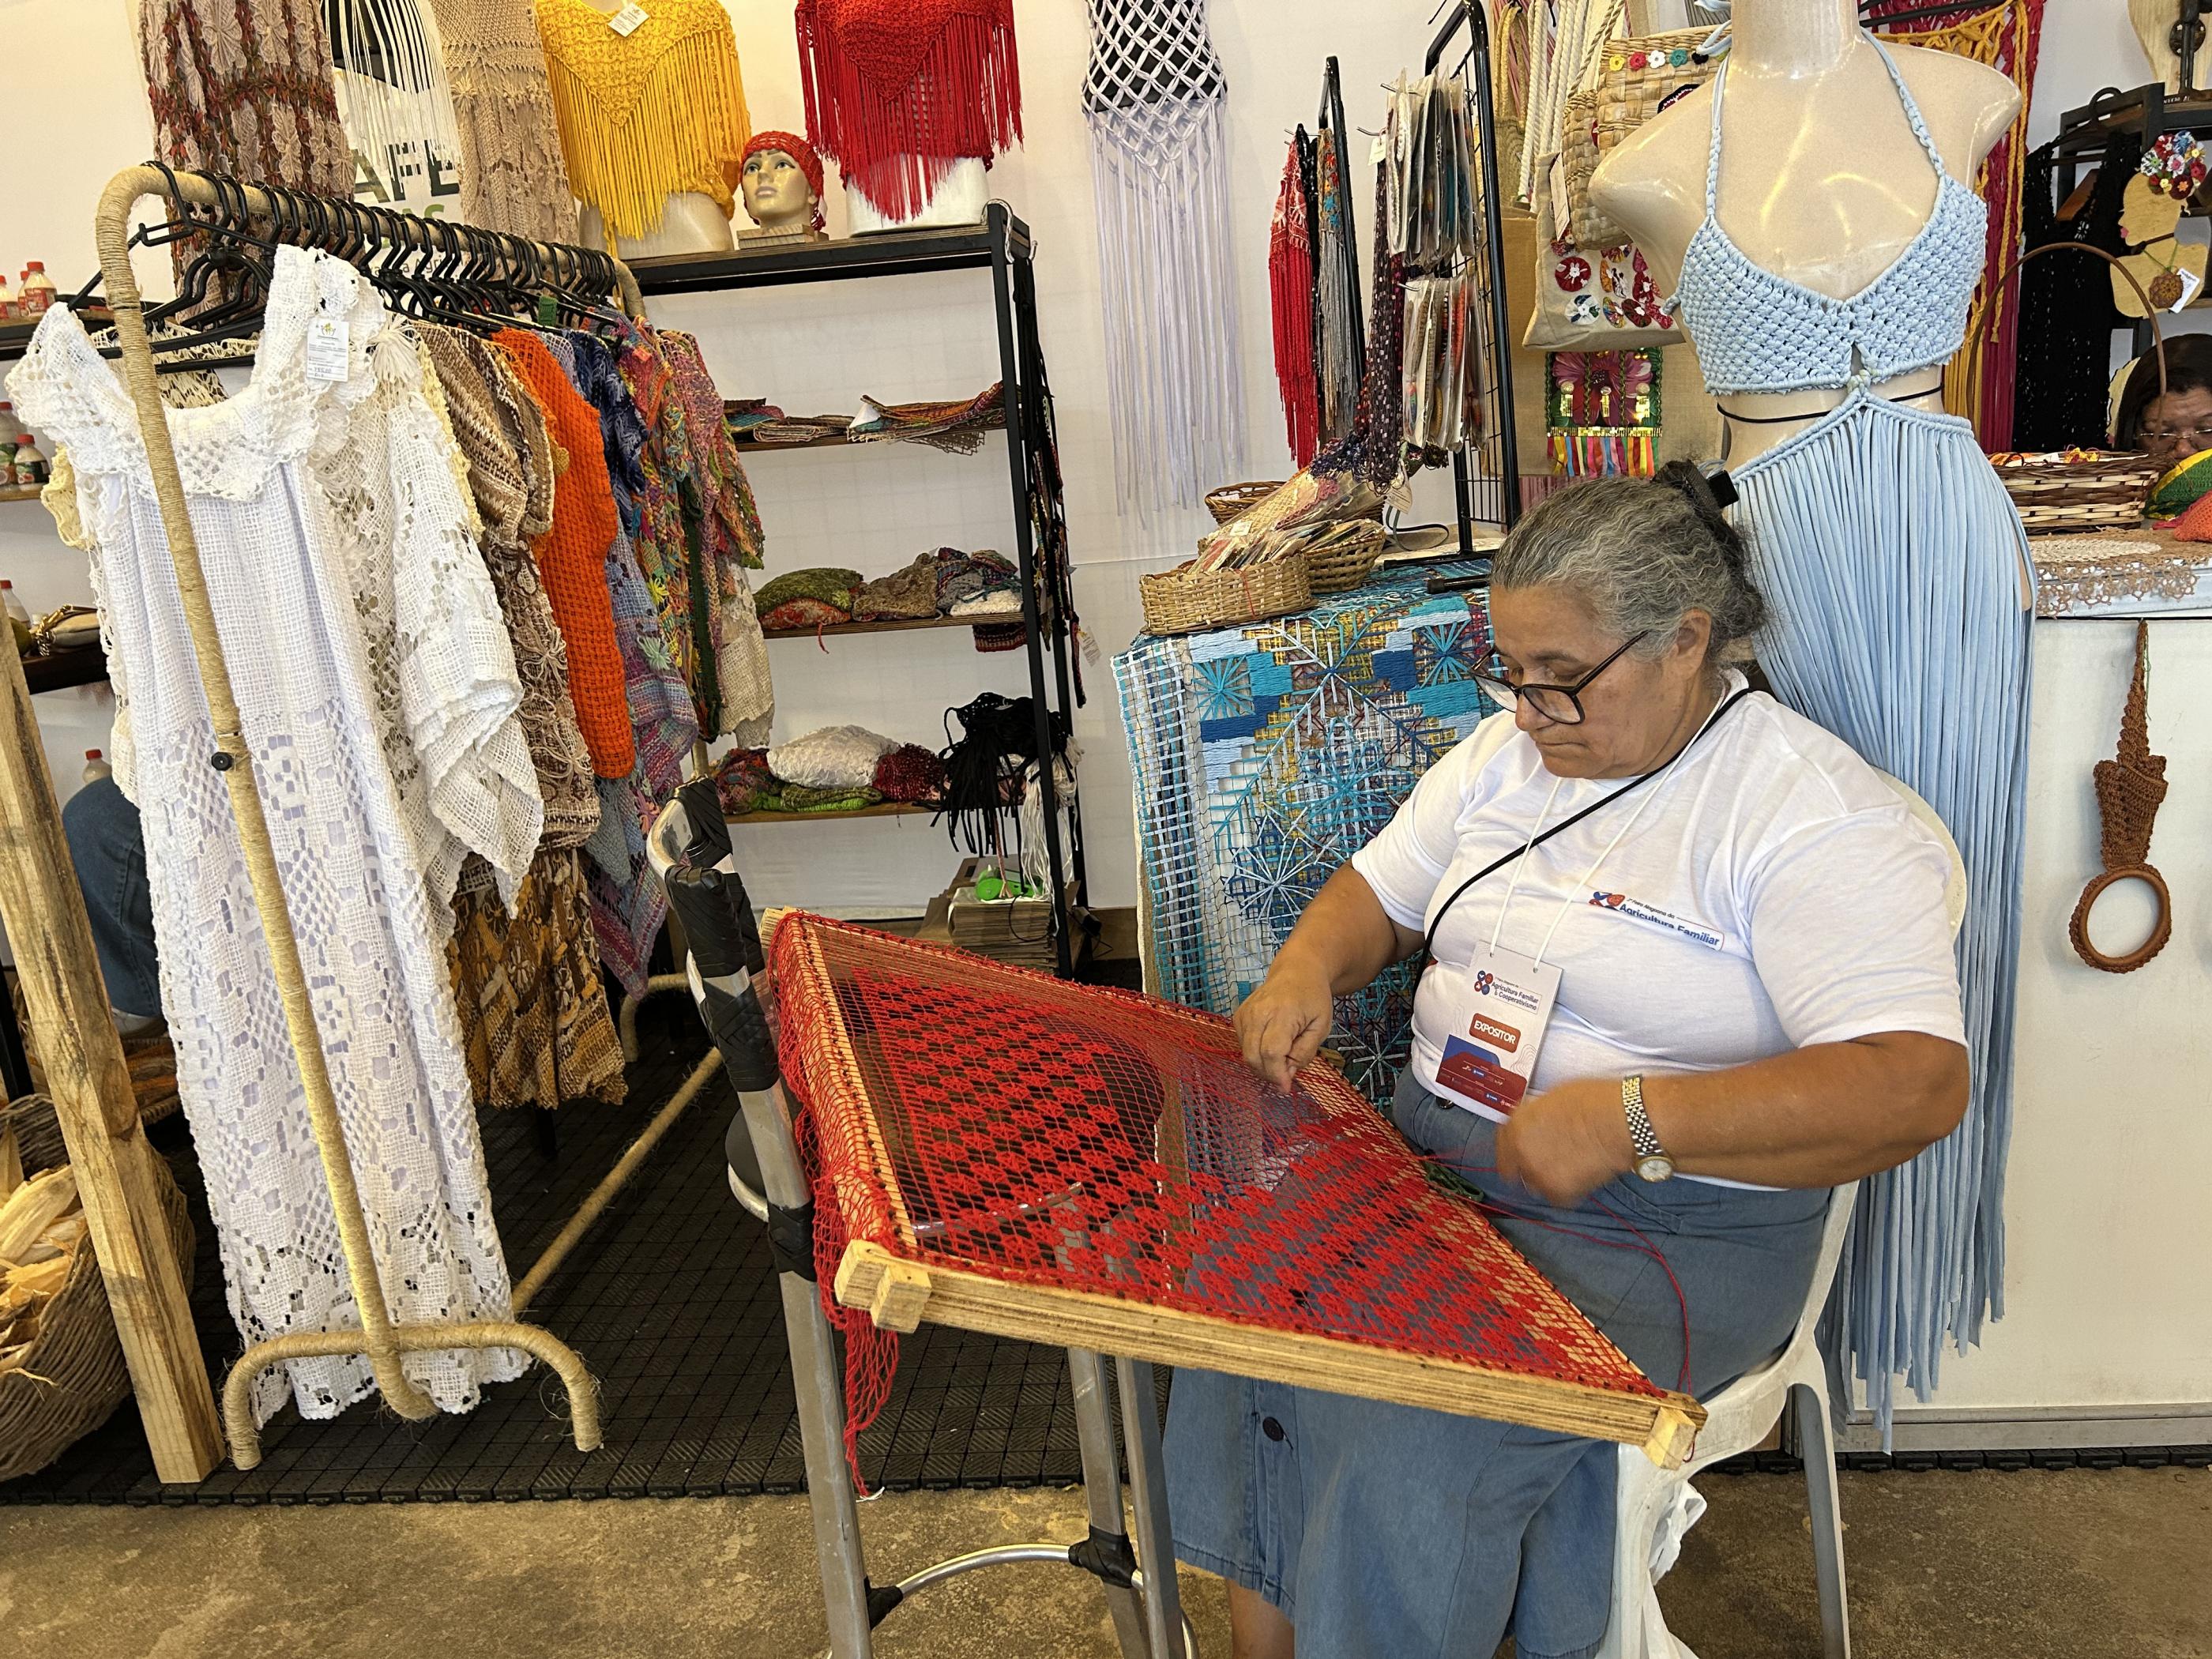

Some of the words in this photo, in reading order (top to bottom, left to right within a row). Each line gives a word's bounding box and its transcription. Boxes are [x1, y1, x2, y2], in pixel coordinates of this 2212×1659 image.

[1620, 903, 1675, 929] Agricultura
[1677, 924, 1720, 946] Familiar
[1492, 982, 1518, 995] Agricultura
[1518, 991, 1539, 1004] Familiar
[1499, 991, 1537, 1010] Cooperativismo
[1473, 1020, 1517, 1044] EXPOSITOR
